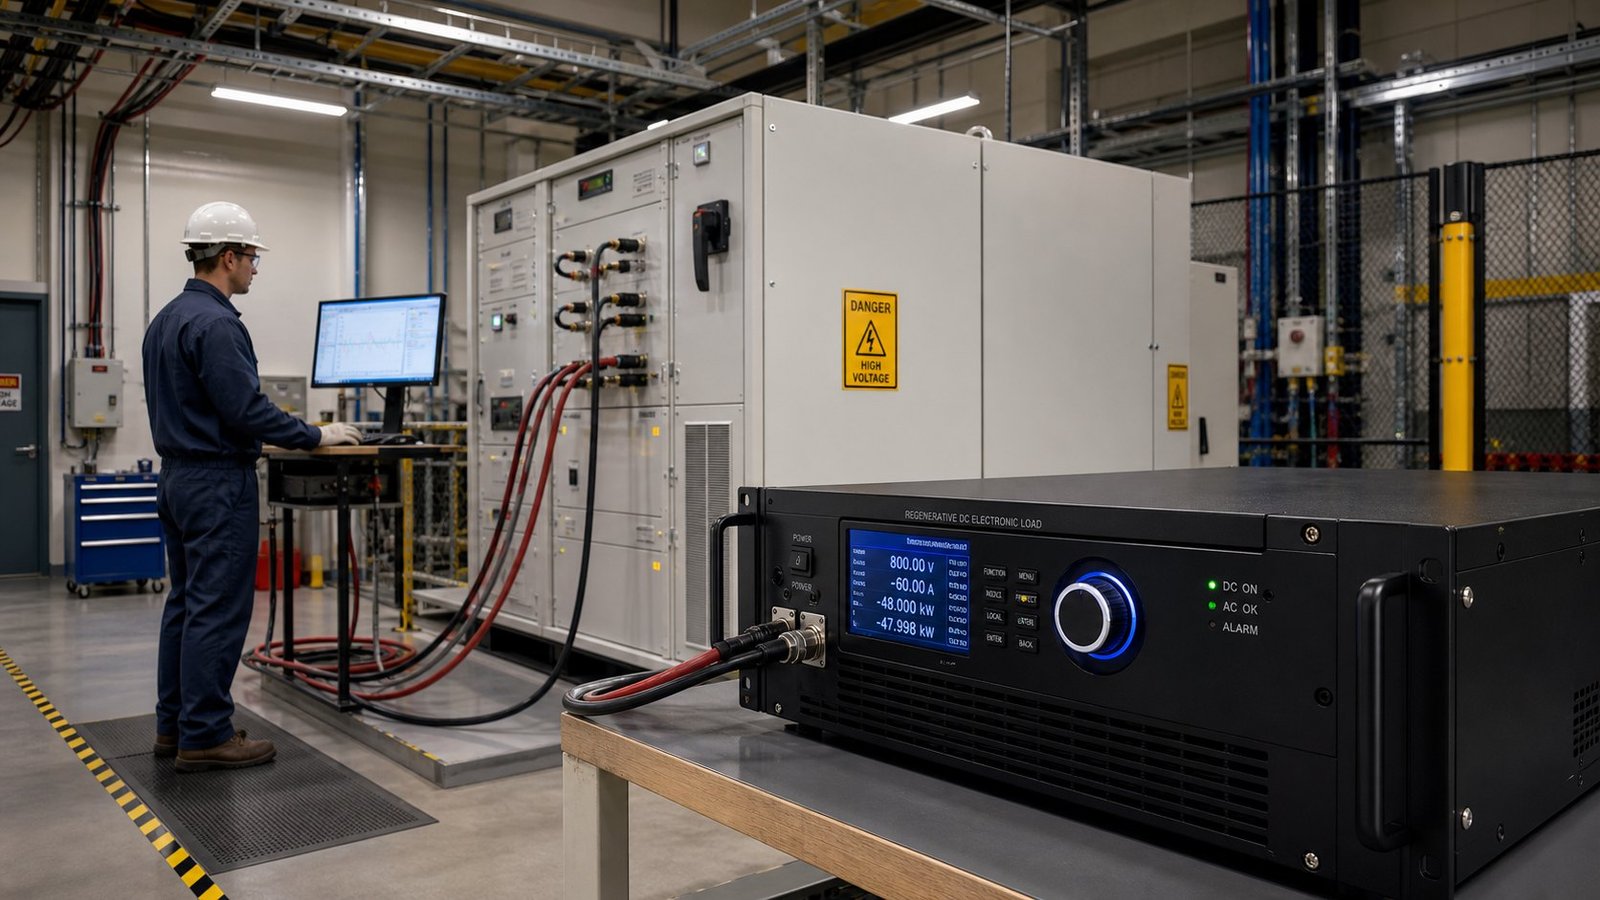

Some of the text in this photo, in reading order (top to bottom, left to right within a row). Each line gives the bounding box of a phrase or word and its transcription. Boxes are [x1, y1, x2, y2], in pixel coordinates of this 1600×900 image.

[850, 300, 892, 314] DANGER
[861, 360, 882, 371] HIGH
[852, 372, 890, 384] VOLTAGE
[904, 509, 1043, 529] REGENERATIVE DC ELECTRONIC LOAD
[792, 533, 813, 544] POWER
[890, 555, 926, 573] 800.00
[927, 561, 935, 574] V
[1018, 572, 1035, 581] MENU
[791, 580, 813, 592] POWER
[890, 577, 926, 595] -60.00
[927, 583, 935, 596] A
[1222, 580, 1258, 595] DC ON
[876, 595, 917, 615] -48.000
[919, 602, 935, 617] kW
[1222, 601, 1258, 615] AC OK
[876, 616, 917, 636] -47.998
[919, 624, 935, 639] kW
[1222, 621, 1259, 636] ALARM
[1018, 639, 1034, 649] BACK
